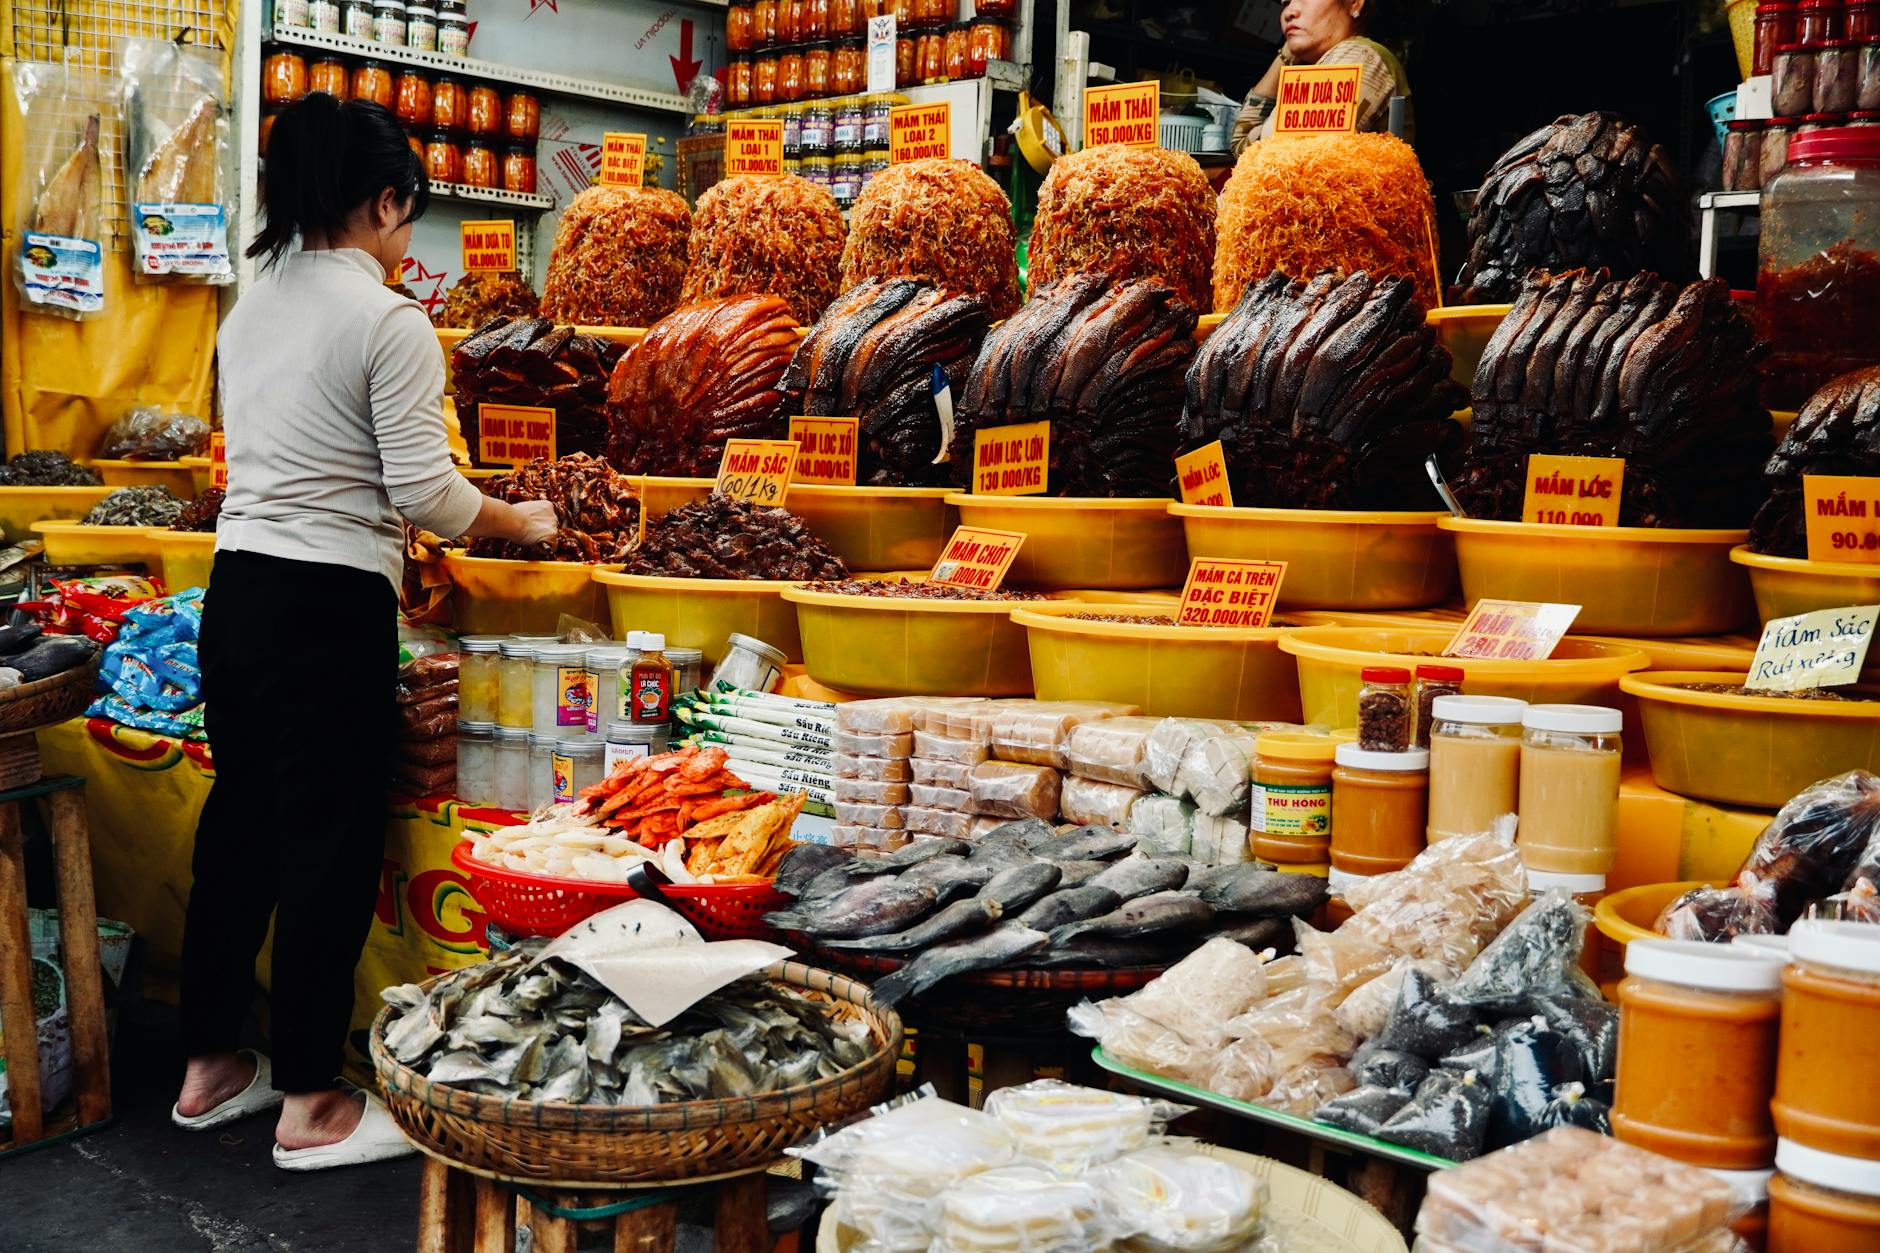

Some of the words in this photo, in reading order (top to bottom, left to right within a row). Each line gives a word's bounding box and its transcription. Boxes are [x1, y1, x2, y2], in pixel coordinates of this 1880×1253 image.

[1283, 74, 1310, 104] MẮM
[1090, 95, 1121, 123] MẮM
[1125, 93, 1153, 120] THÁI
[895, 112, 919, 130] MẮM
[923, 109, 945, 126] THÁI
[1284, 109, 1346, 129] 60.000/KG
[732, 125, 755, 141] MẮM
[758, 125, 778, 141] THÁI
[904, 129, 926, 145] LOẠI
[929, 128, 935, 141] 2
[1090, 123, 1152, 145] 150.000/KG
[626, 142, 641, 154] THÁI
[741, 143, 761, 158] LOẠI
[764, 144, 769, 155] 1
[894, 143, 945, 161] 160.000/KG
[623, 156, 638, 172] BIỆT
[731, 159, 778, 172] 170.000/KG
[465, 228, 483, 249] MẮM
[501, 233, 511, 249] TO
[469, 253, 508, 267] 60.000/KG
[727, 448, 760, 473] MẮM
[762, 453, 788, 478] SẶC
[1535, 470, 1575, 496] MẮM
[1578, 474, 1613, 499] LÓC
[1817, 491, 1866, 518] MẮM
[947, 536, 981, 562] MẮM
[1195, 565, 1225, 584] MẮM
[1226, 568, 1243, 585] CÁ
[1189, 586, 1225, 606] ĐẶC
[1228, 588, 1270, 609] BIỆT
[1182, 607, 1263, 627] 320.000/KG
[781, 769, 799, 781] Sầu
[801, 772, 831, 790] Riêng
[1267, 797, 1287, 807] THU
